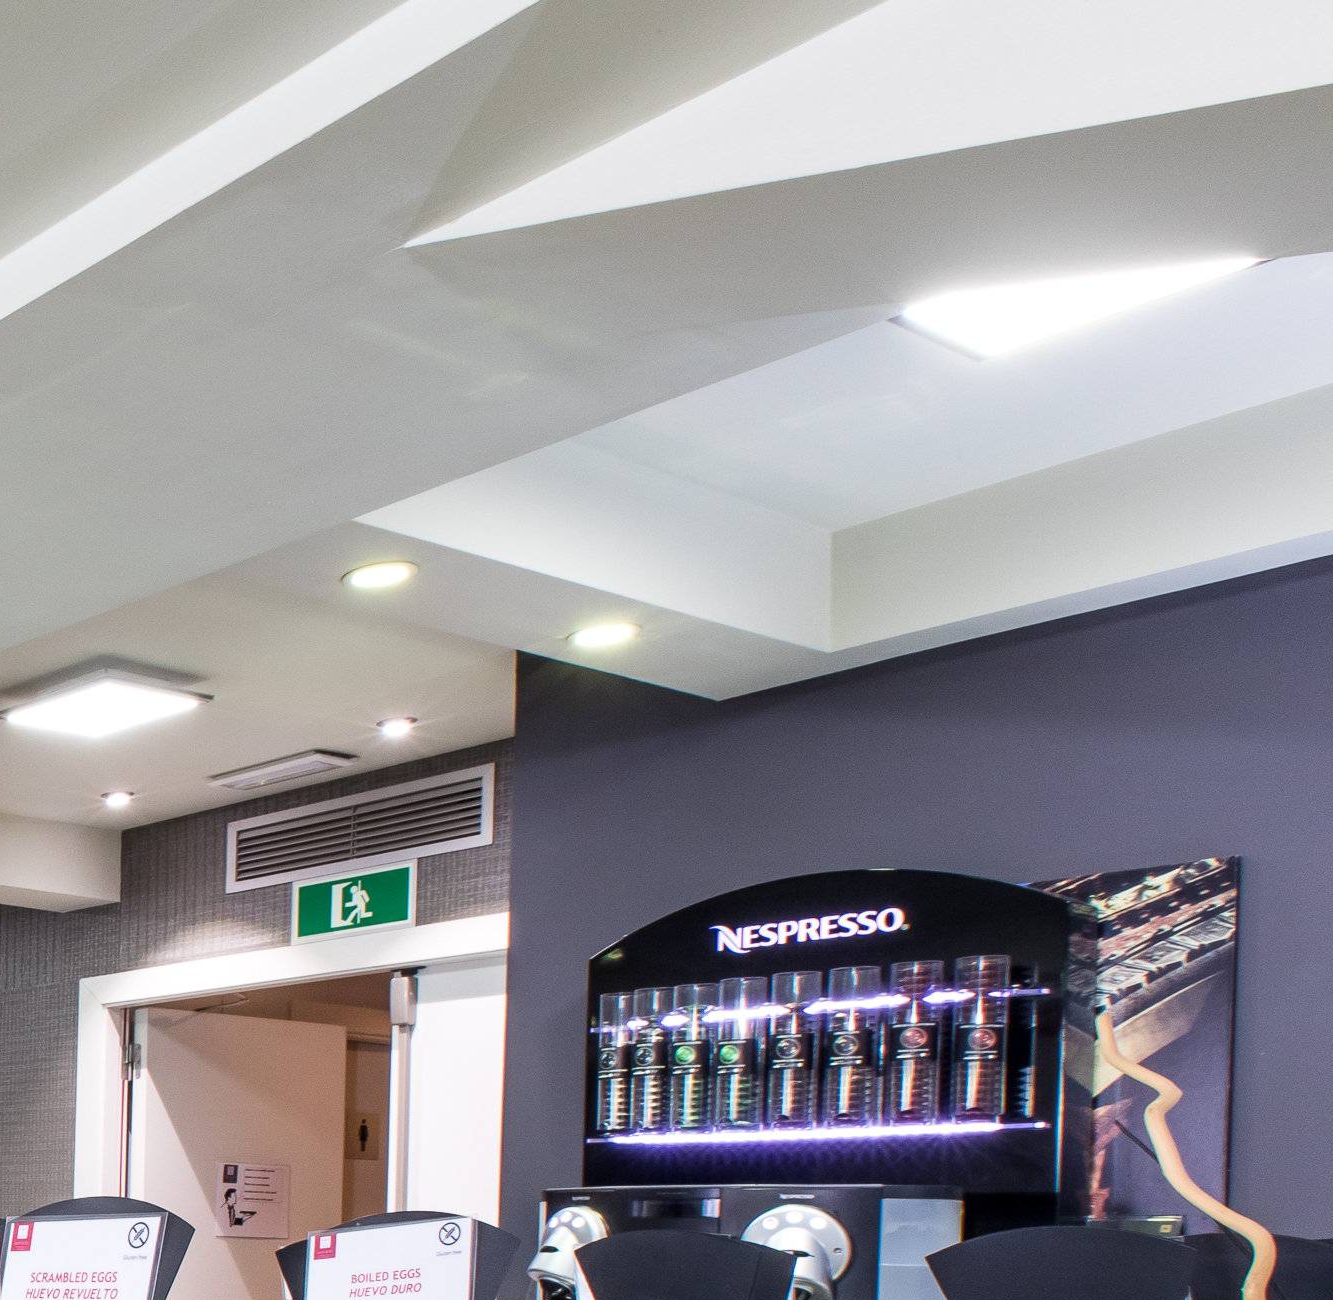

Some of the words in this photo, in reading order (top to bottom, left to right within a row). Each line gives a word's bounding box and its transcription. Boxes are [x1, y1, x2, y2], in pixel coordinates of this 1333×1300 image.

[709, 907, 906, 954] NESPRESSO
[30, 1271, 88, 1283] SCRAMBLED
[91, 1271, 118, 1283] EGGS
[351, 1271, 389, 1284] BOILED
[392, 1268, 421, 1281] EGGS
[25, 1288, 61, 1300] HUEVO
[63, 1288, 119, 1300] REVUELTO
[349, 1285, 388, 1298] HUEVO
[390, 1282, 422, 1295] DURO
